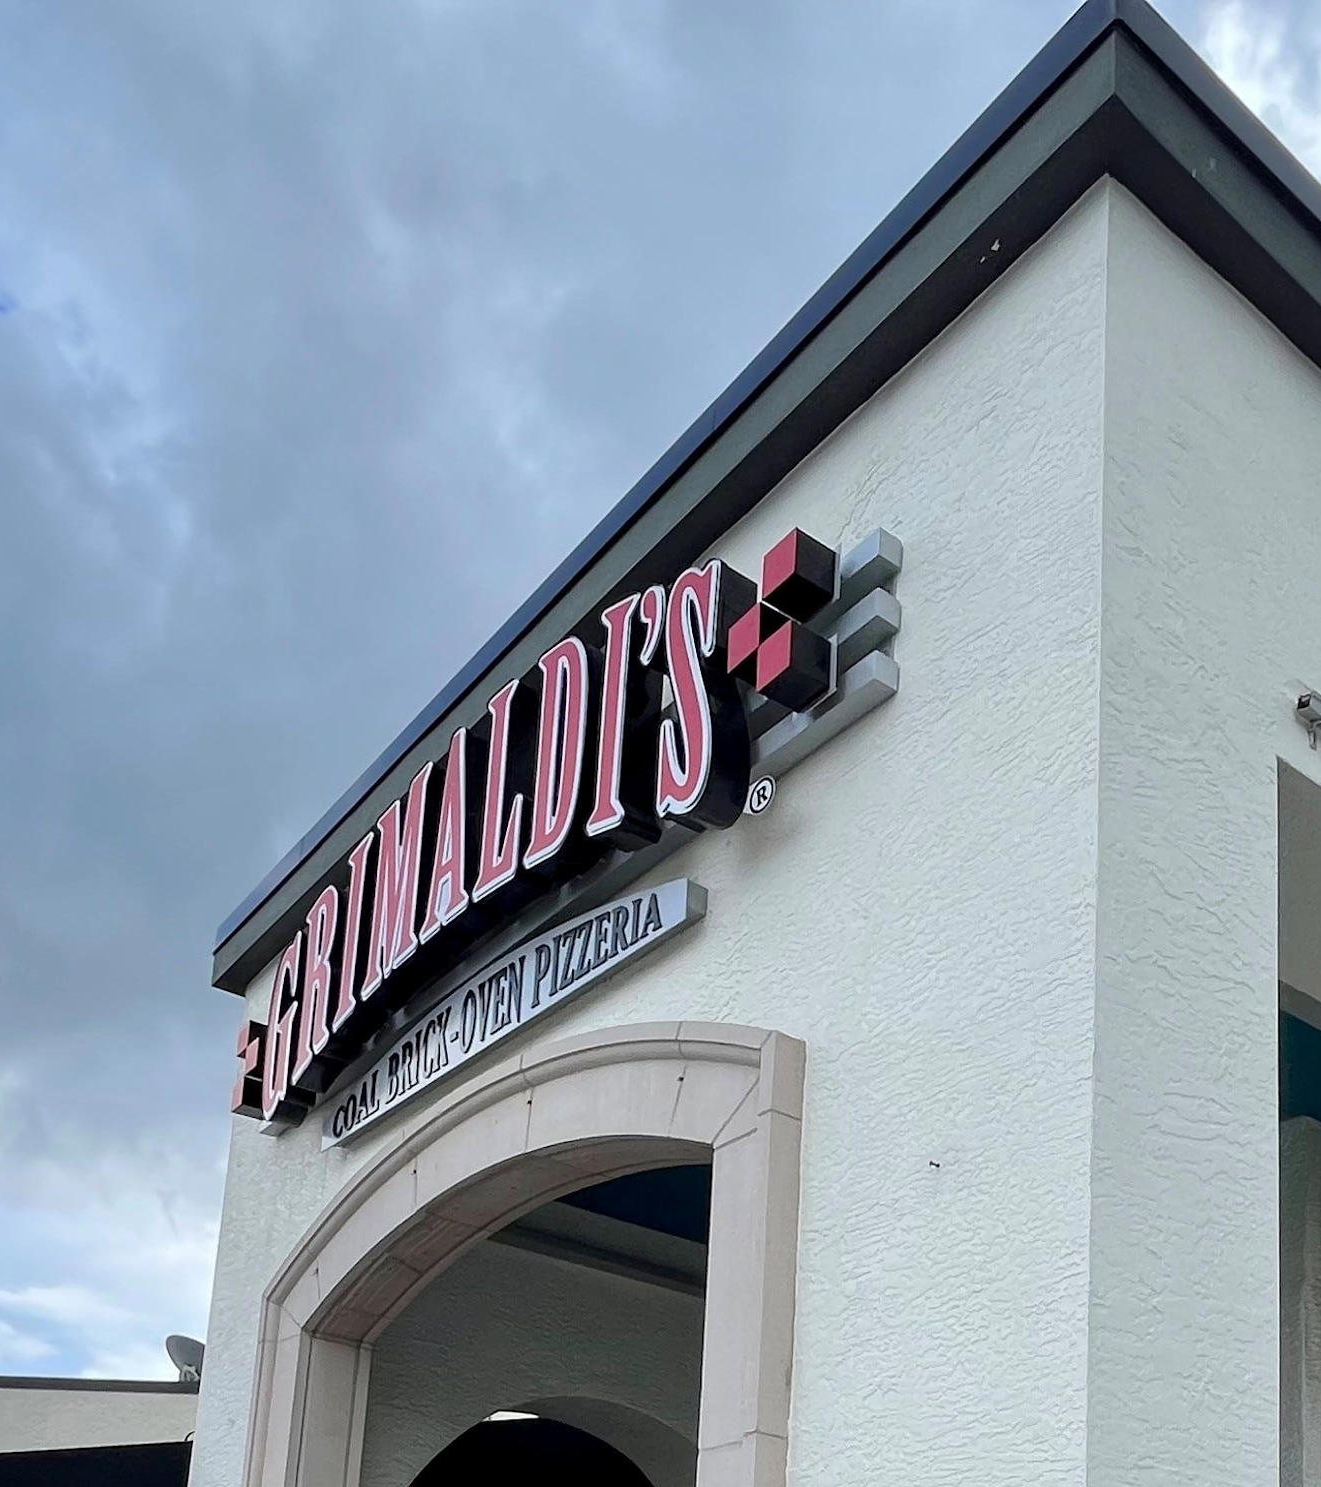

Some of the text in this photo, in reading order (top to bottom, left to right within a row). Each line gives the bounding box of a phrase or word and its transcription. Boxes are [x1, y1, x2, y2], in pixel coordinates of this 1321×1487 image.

[260, 557, 722, 1121] GRIMALDI'S
[331, 892, 663, 1139] COAL BRICK-OVEN PIZZERIA
